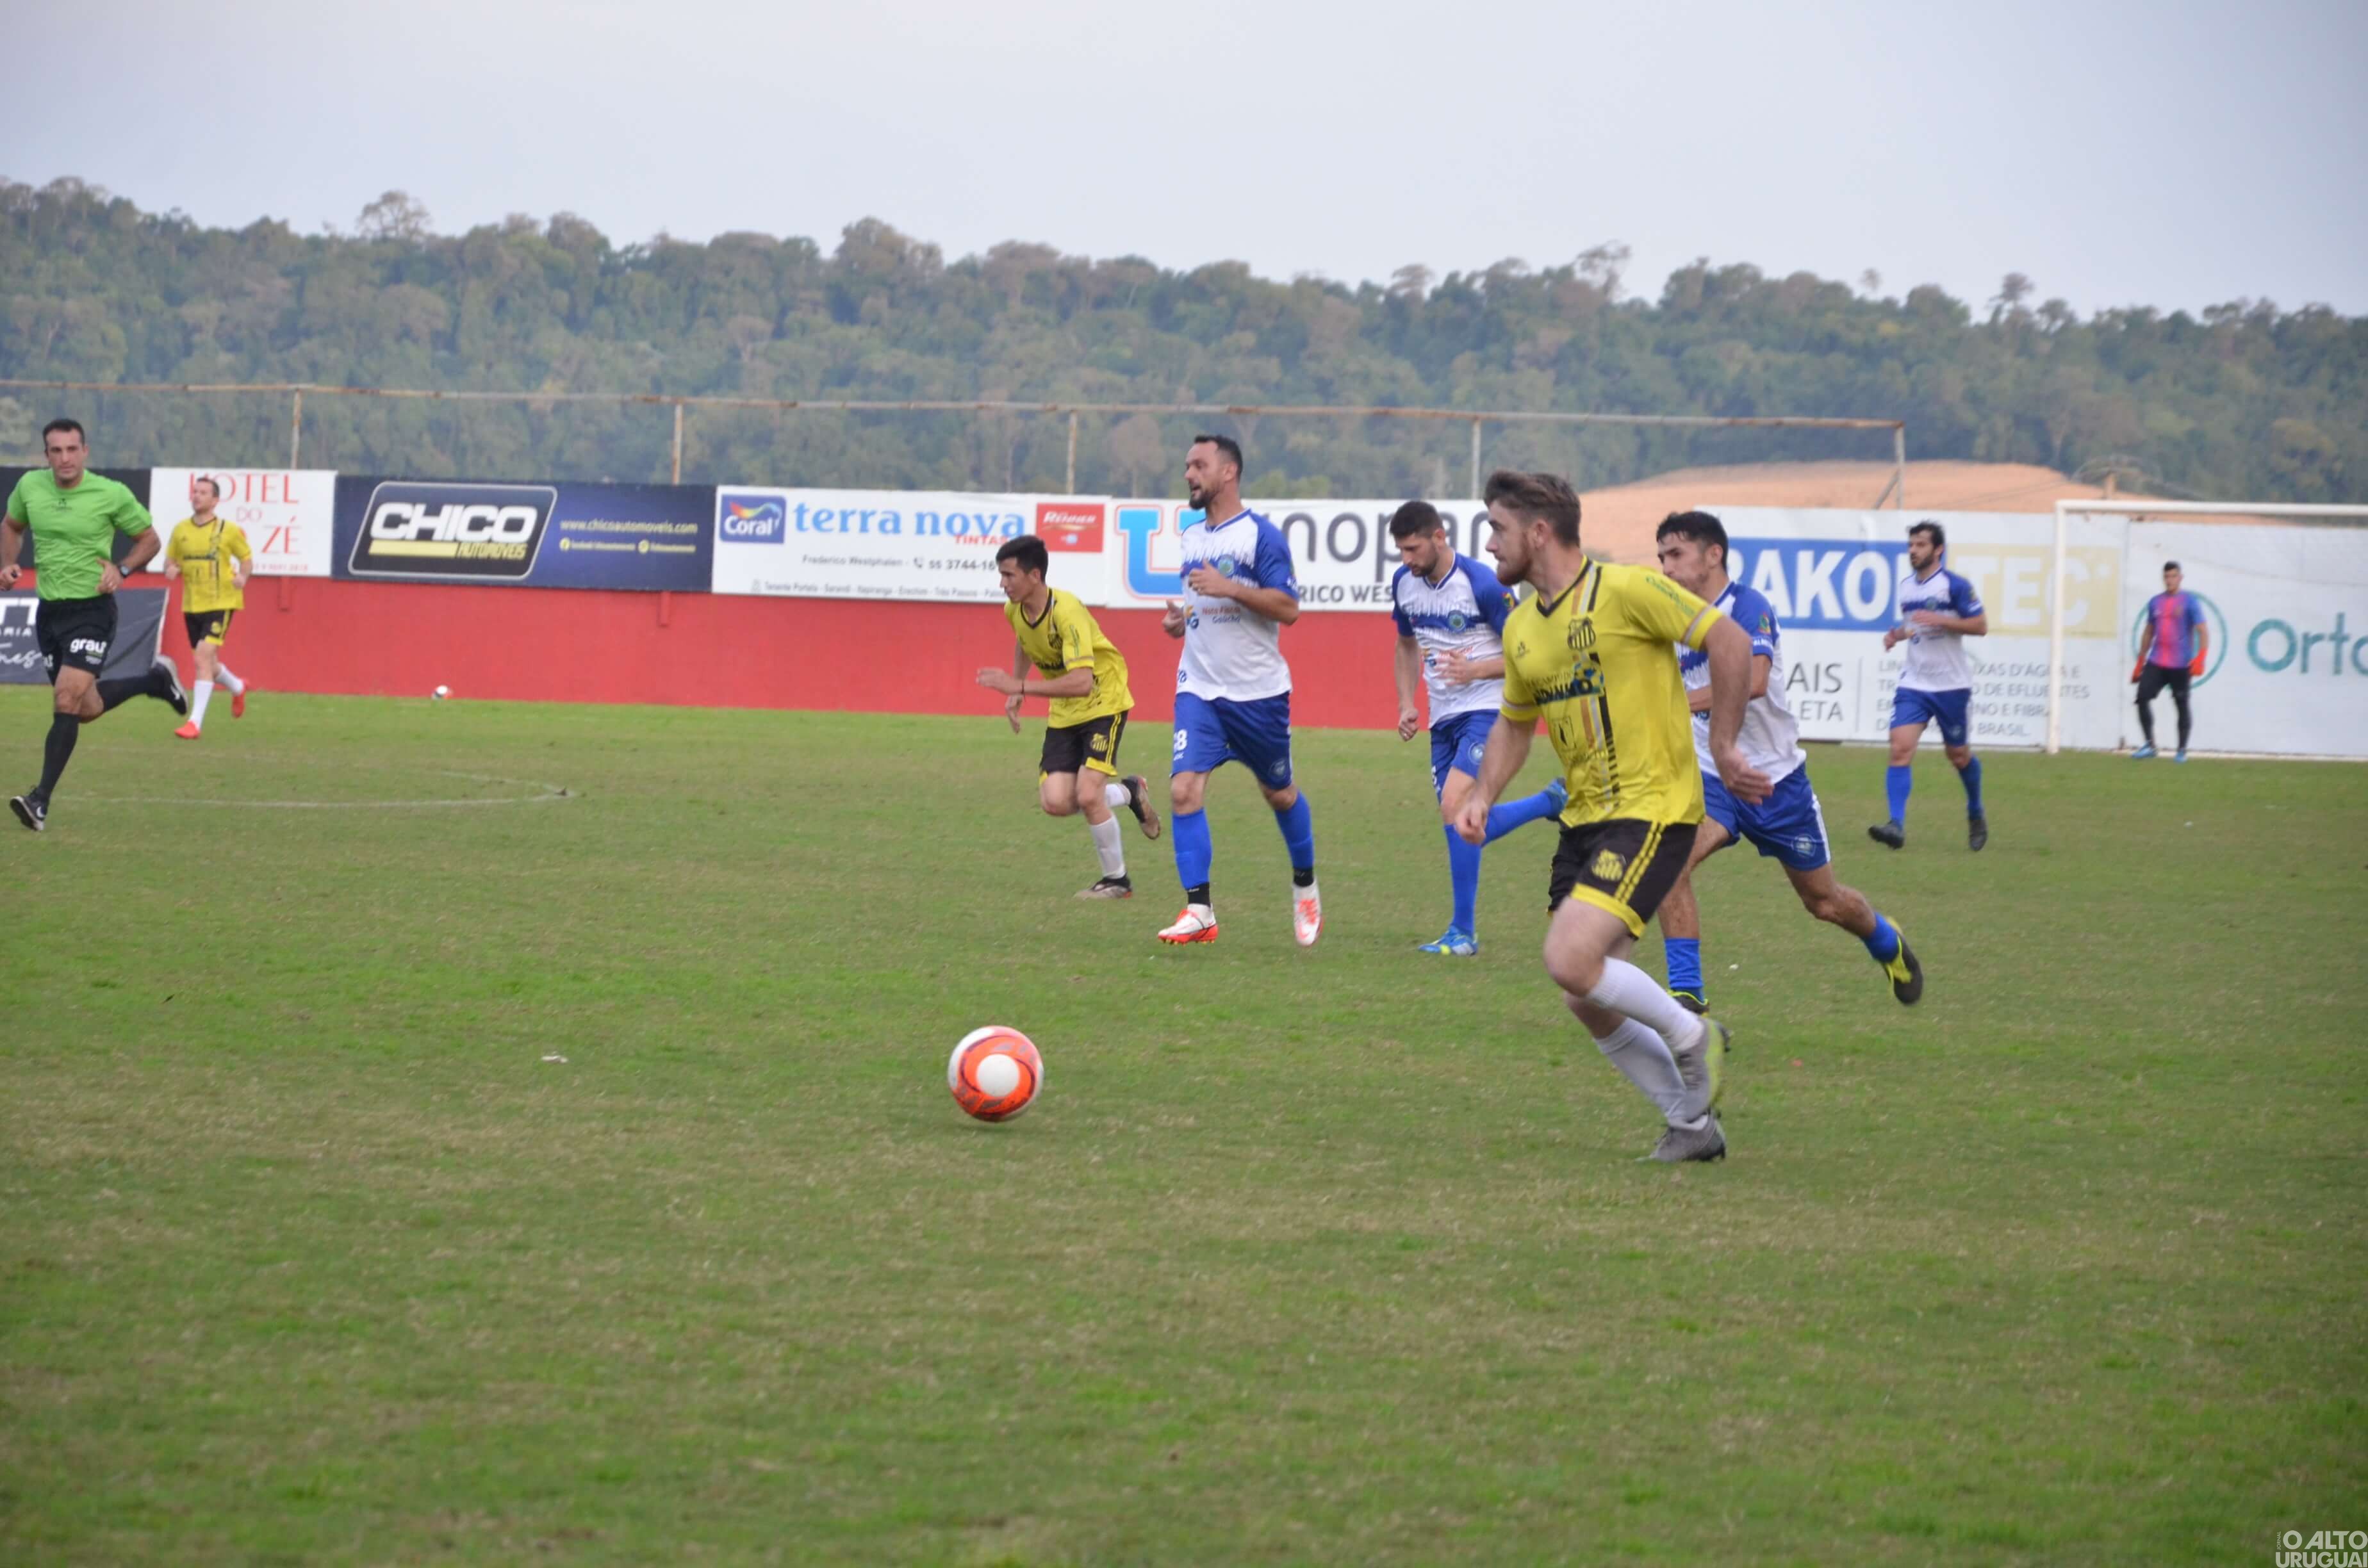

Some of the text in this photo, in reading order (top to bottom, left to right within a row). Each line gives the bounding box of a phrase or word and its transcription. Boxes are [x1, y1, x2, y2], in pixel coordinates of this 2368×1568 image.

[236, 506, 262, 522] DO
[370, 502, 538, 544] CHICO
[724, 514, 773, 536] Coral
[794, 502, 1025, 537] terra nova
[262, 515, 301, 554] ZÉ
[953, 534, 1008, 546] TINTAS
[1267, 511, 1489, 584] nopr
[946, 559, 998, 571] 3744-16
[1298, 585, 1395, 603] RICO WES
[0, 626, 33, 637] RIA
[1786, 662, 1842, 693] AIS
